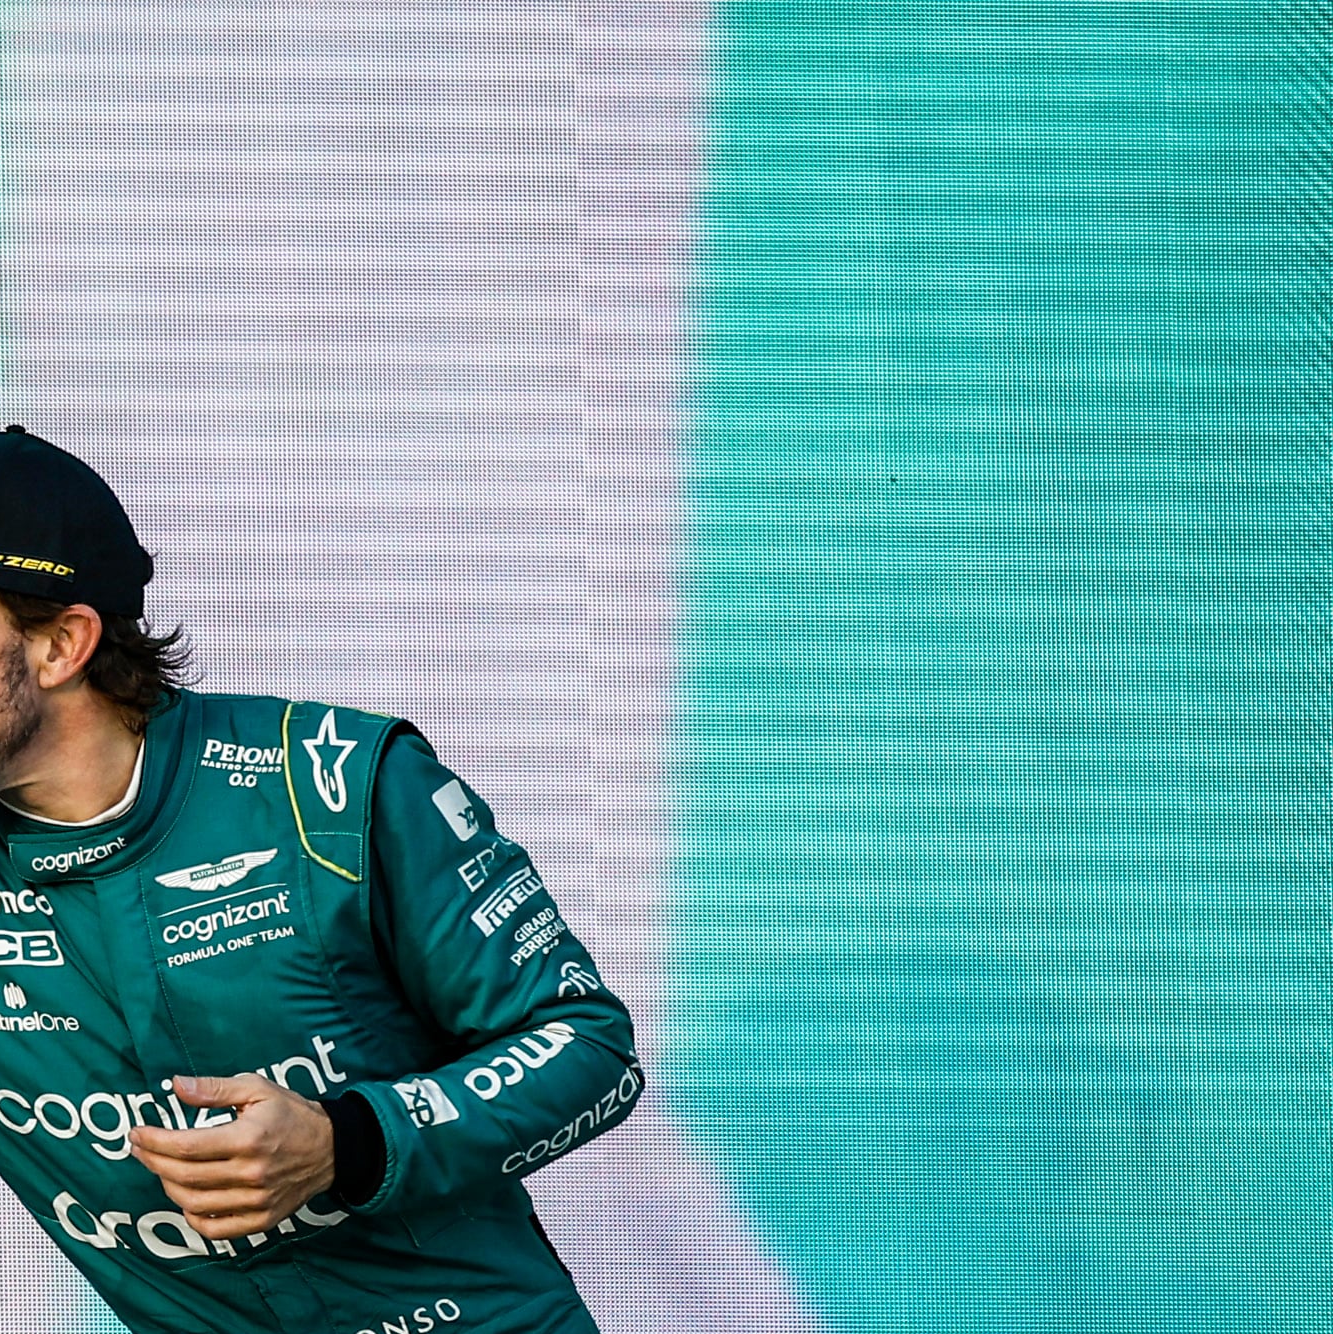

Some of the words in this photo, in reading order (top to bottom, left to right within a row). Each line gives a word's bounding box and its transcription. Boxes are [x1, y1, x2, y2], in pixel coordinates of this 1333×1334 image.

[31, 836, 127, 873] cognizant
[192, 868, 215, 881] ASTON
[215, 860, 244, 874] MARTIN
[162, 891, 290, 945] cognizant
[514, 907, 555, 943] GIRARD
[167, 943, 226, 968] FORMULA
[259, 925, 295, 942] TEAM
